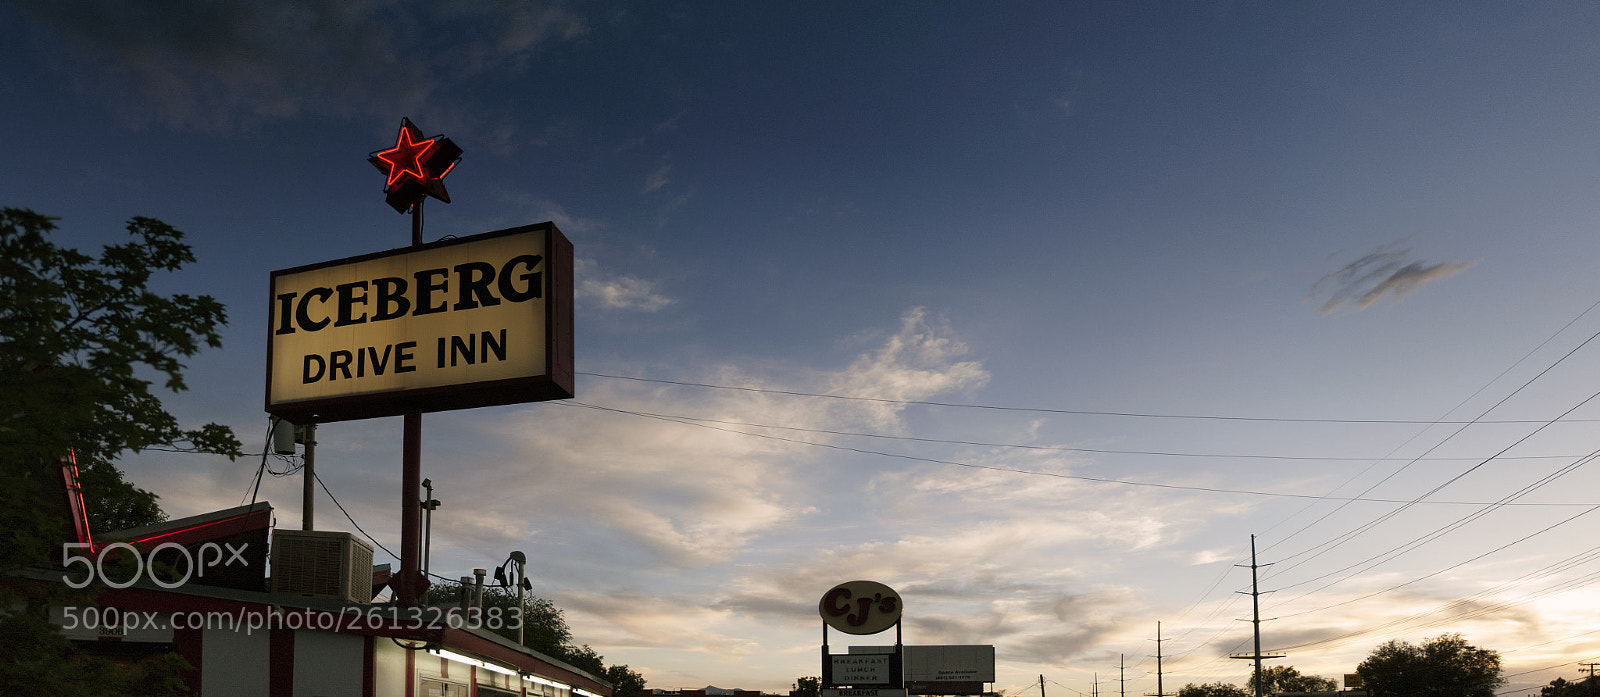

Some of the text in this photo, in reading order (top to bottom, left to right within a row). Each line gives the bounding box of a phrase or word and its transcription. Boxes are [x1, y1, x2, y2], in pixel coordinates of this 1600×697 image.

[275, 254, 543, 335] ICEBERG
[302, 328, 507, 384] DRIVE INN
[824, 588, 897, 627] CJ's
